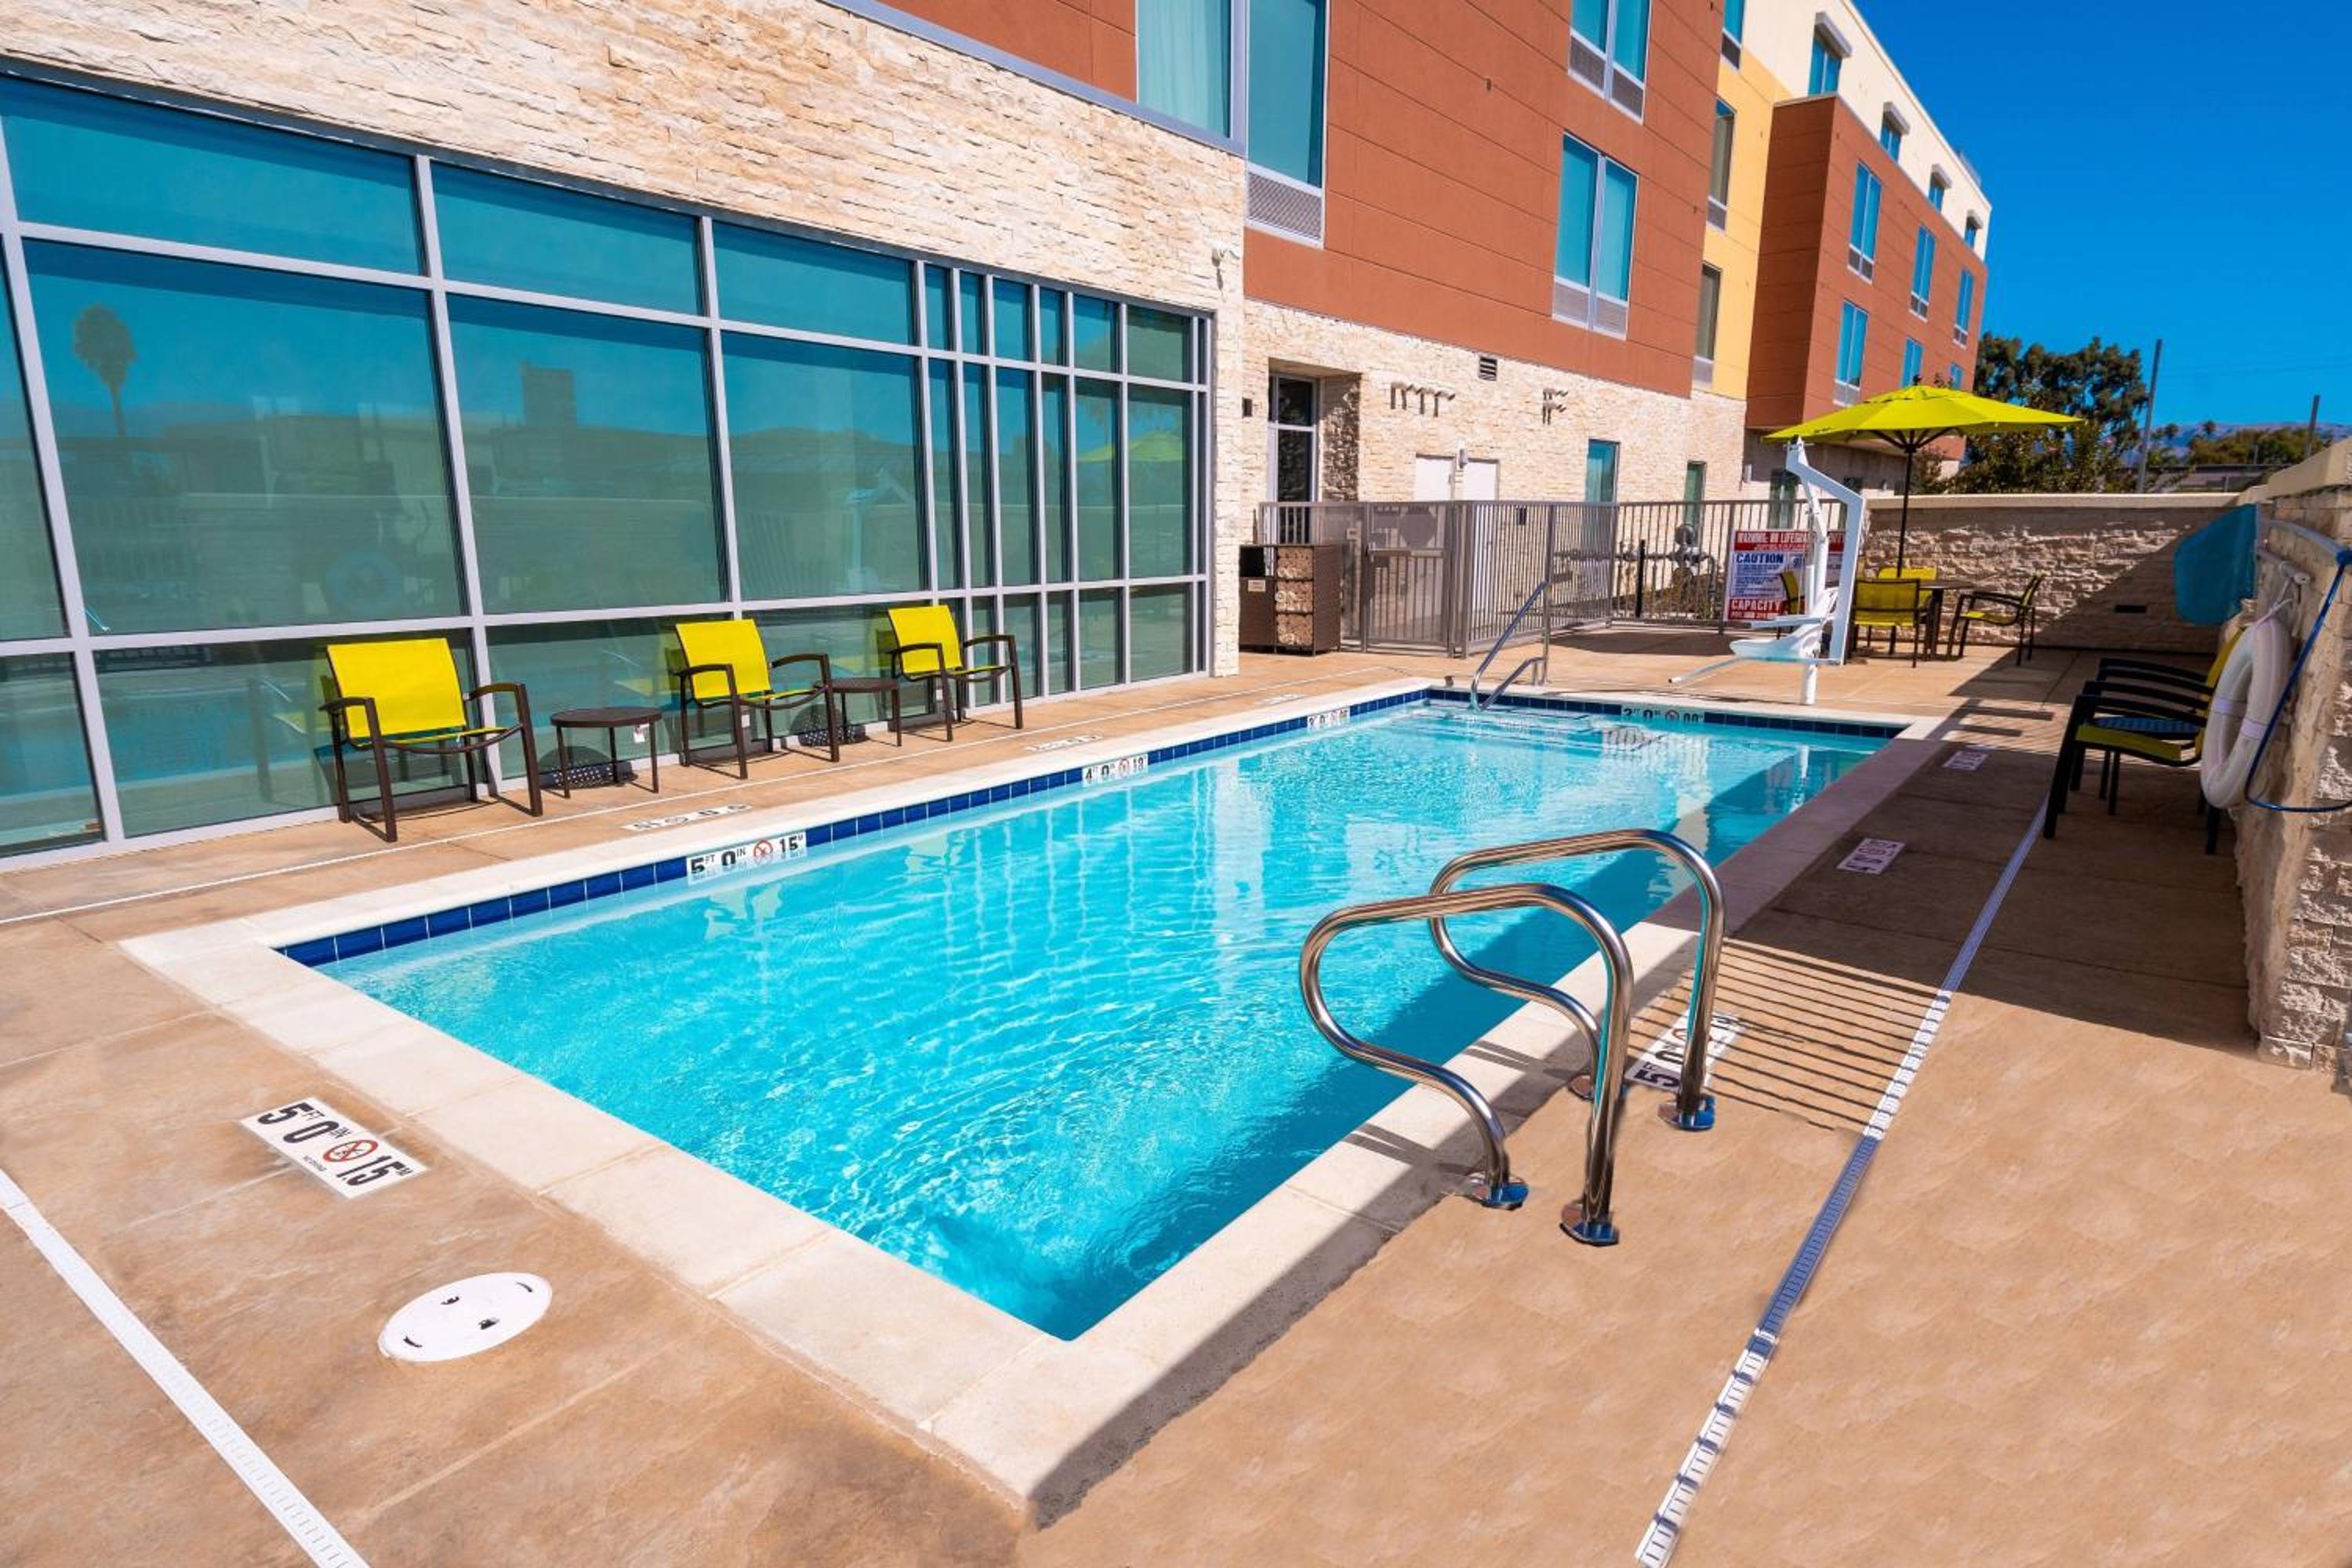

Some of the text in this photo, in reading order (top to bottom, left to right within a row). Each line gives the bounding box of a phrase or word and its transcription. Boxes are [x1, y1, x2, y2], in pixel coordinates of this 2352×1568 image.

[1736, 553, 1784, 564] CAUTION
[1731, 599, 1782, 611] CAPACITY
[691, 858, 705, 874] 5
[721, 851, 736, 866] 0
[1634, 1069, 1681, 1087] 5
[257, 1102, 314, 1125] 5
[282, 1120, 339, 1144] 0
